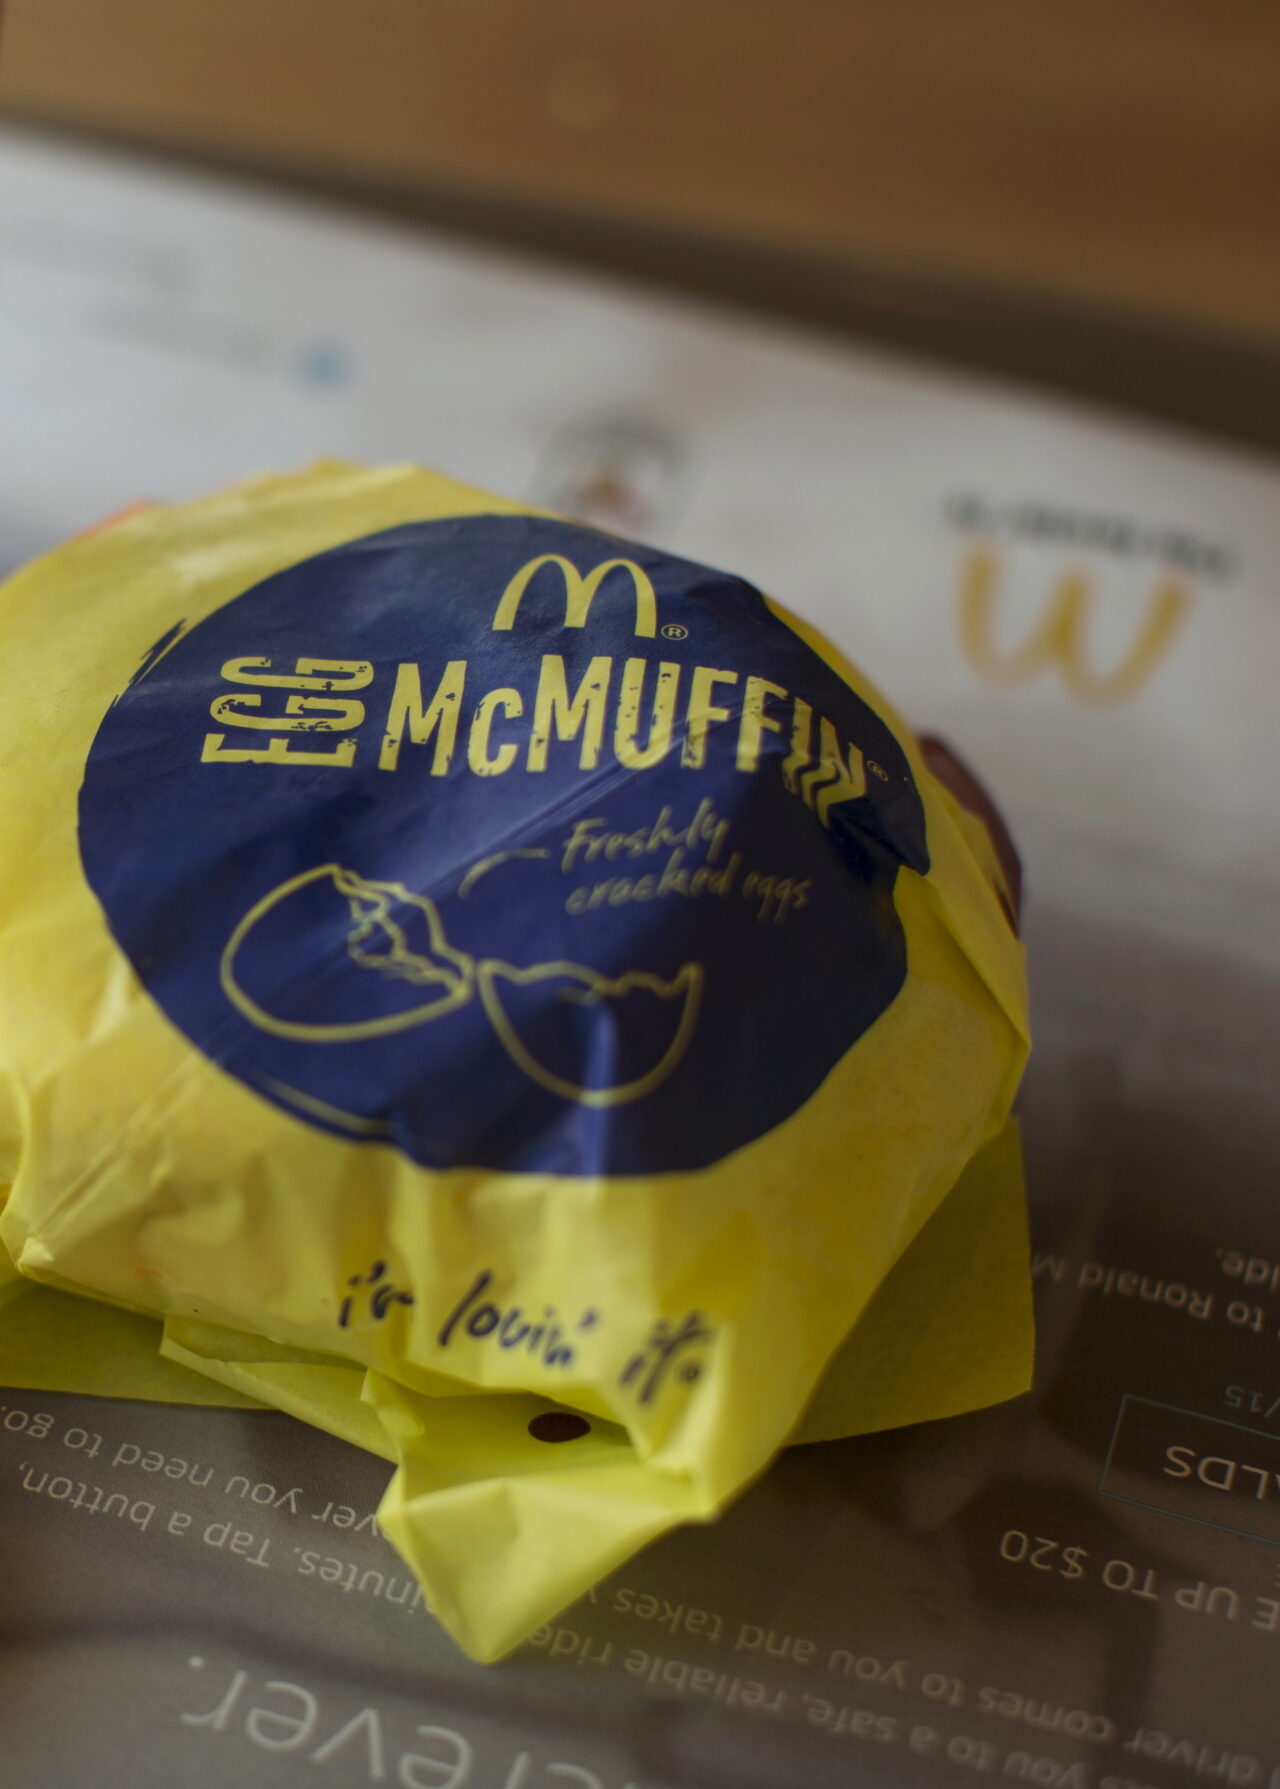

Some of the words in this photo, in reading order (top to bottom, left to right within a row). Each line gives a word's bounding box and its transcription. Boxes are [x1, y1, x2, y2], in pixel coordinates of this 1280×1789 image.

[200, 656, 374, 768] EGG
[377, 654, 868, 830] McMUFFIN
[561, 797, 730, 874] Freshly
[565, 846, 743, 915] cracked
[742, 868, 814, 924] eggs
[1078, 1259, 1215, 1323] Ronald
[1226, 1301, 1265, 1334] to
[0, 1405, 55, 1439] go.
[62, 1427, 103, 1459] to
[111, 1443, 215, 1487] need
[1163, 1445, 1280, 1501] LDS
[19, 1461, 157, 1532] button,
[224, 1475, 304, 1515] you
[167, 1510, 193, 1537] a
[203, 1521, 271, 1569] Tap
[999, 1529, 1090, 1580] $20
[293, 1547, 434, 1614] inutes.
[1101, 1558, 1160, 1600] TO
[1174, 1580, 1241, 1621] UP
[613, 1587, 725, 1644] takes
[734, 1622, 817, 1665] and
[623, 1647, 787, 1714] reliable
[826, 1647, 912, 1689] you
[920, 1671, 967, 1706] to
[801, 1691, 901, 1745] safe,
[907, 1724, 941, 1753] a
[976, 1686, 1115, 1744] comes
[946, 1734, 995, 1772] to
[1122, 1726, 1263, 1786] driver
